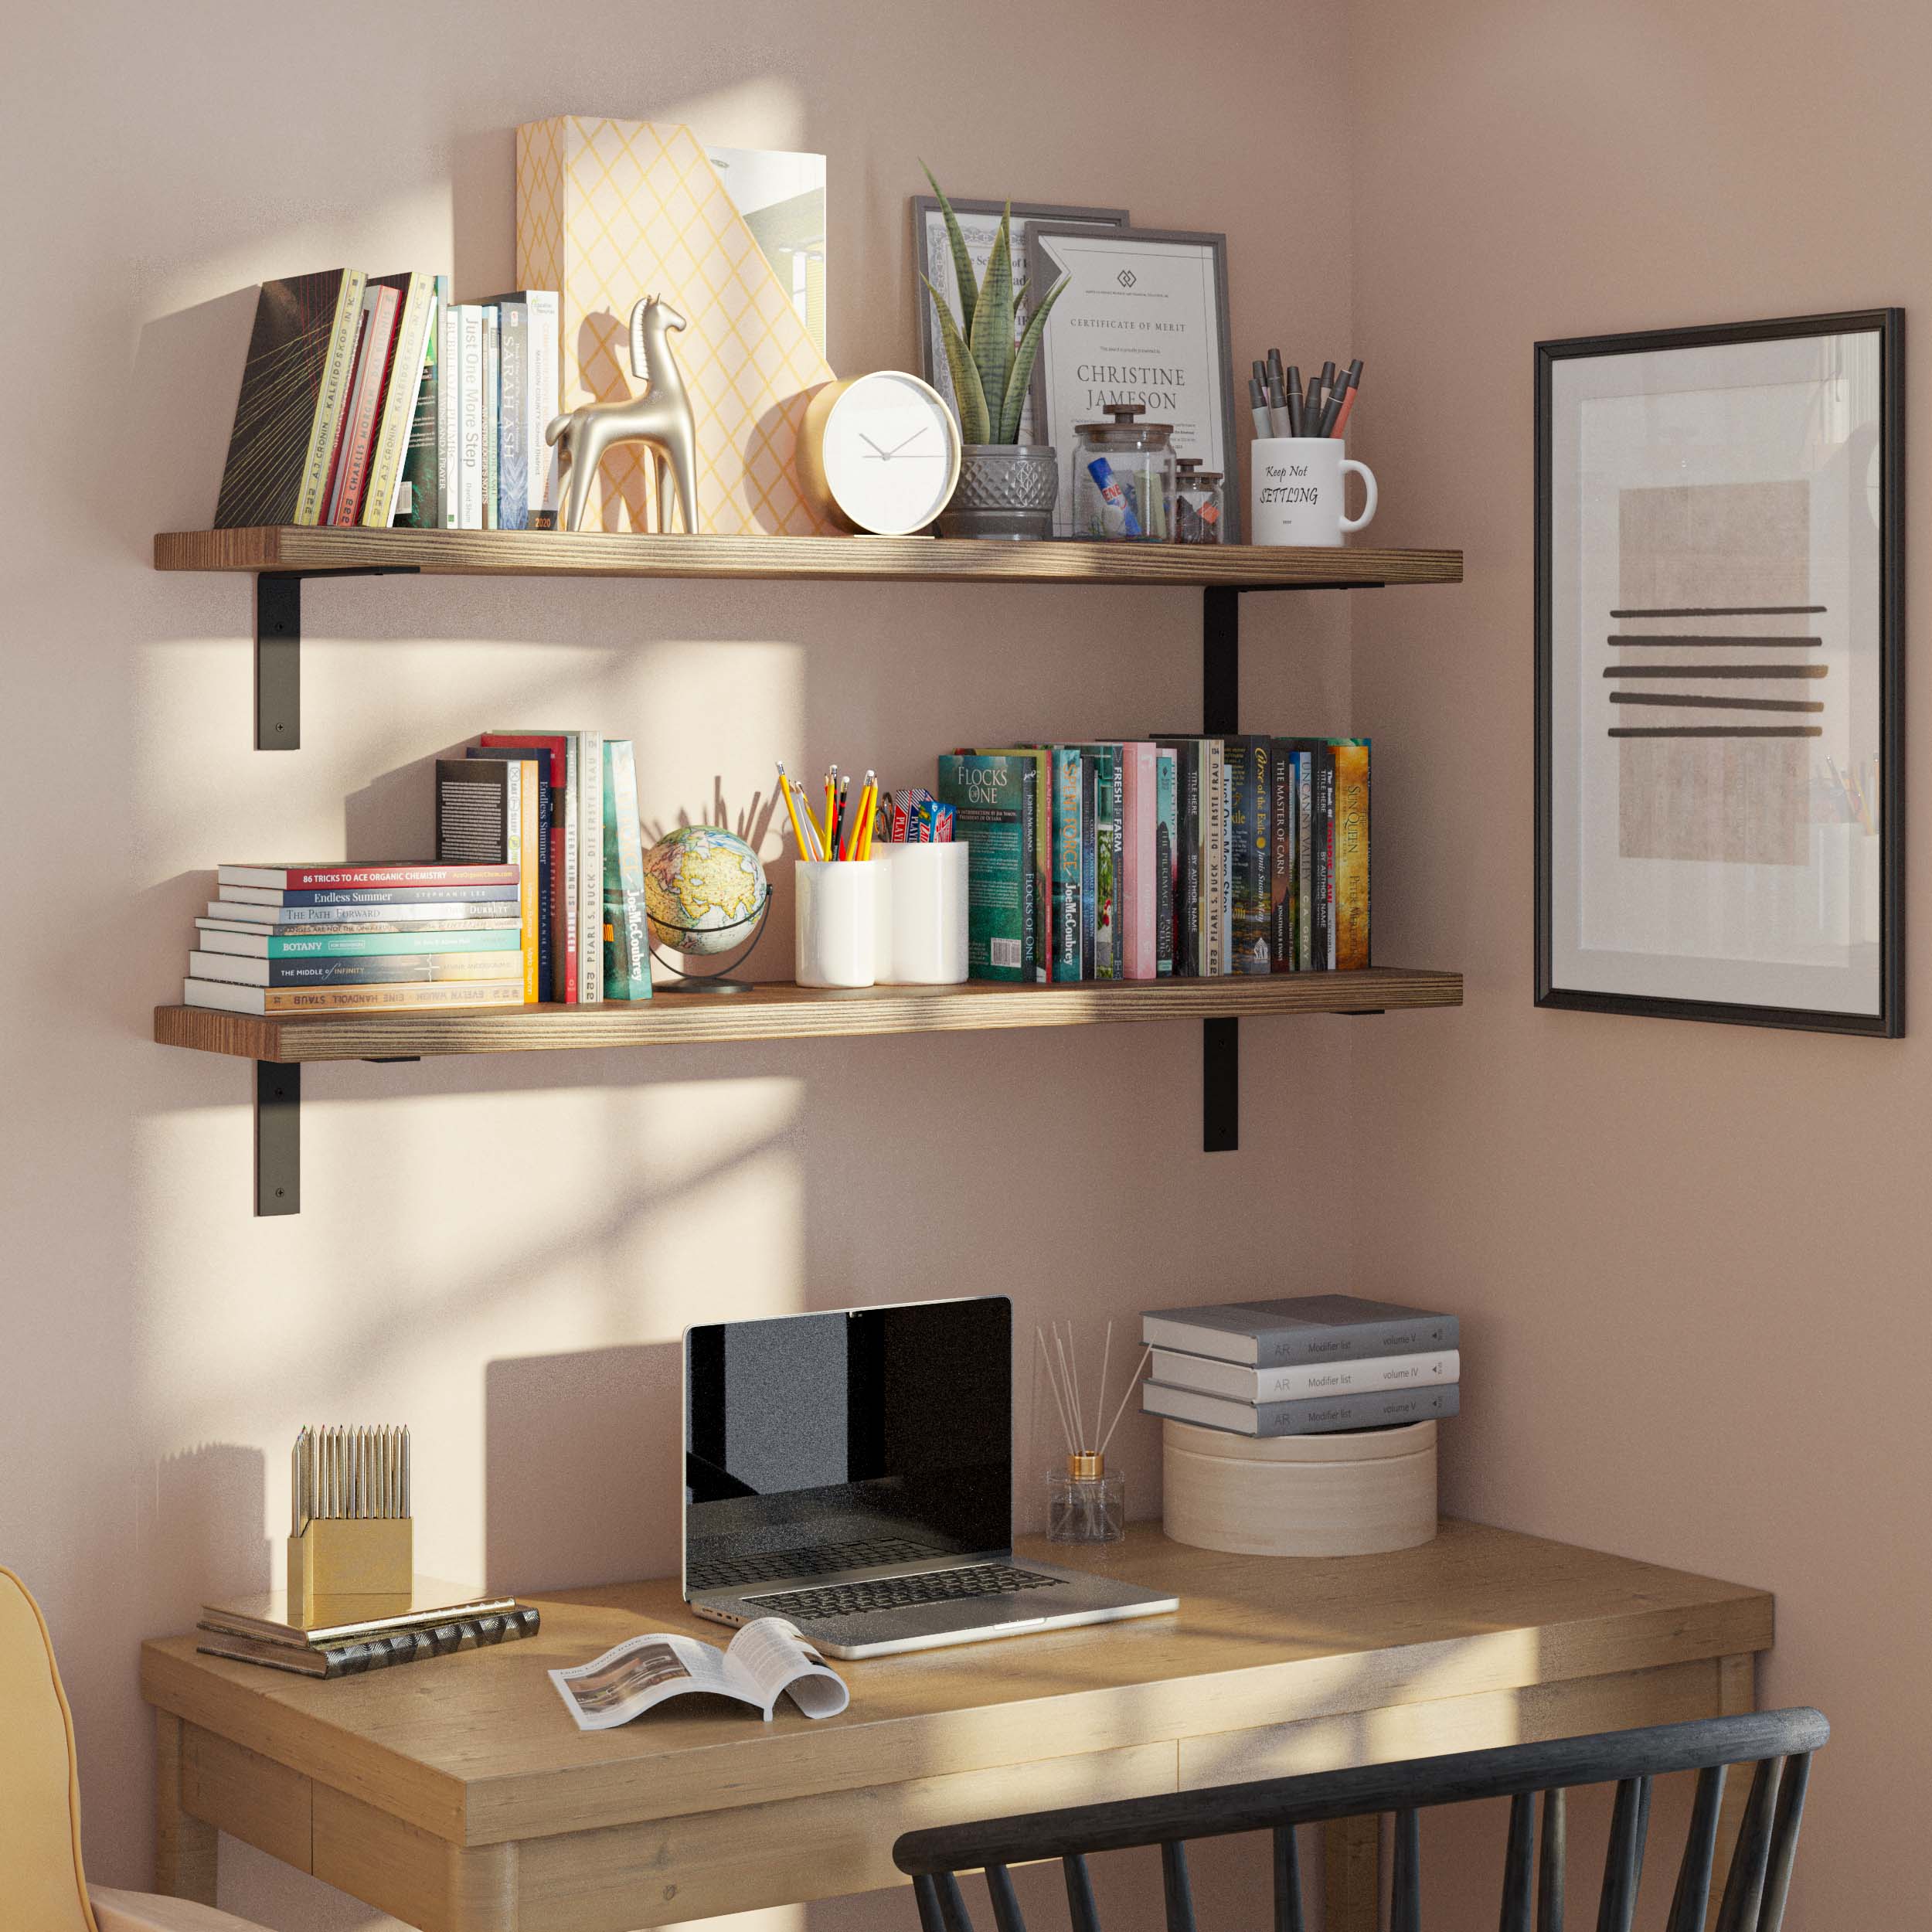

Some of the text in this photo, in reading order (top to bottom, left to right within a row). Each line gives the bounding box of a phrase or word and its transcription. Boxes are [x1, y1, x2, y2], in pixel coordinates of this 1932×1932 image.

[1070, 318, 1186, 332] CERTIFICATE OF MERIT
[1077, 364, 1186, 386] CHRISTINE
[315, 421, 329, 459] CRONIN
[325, 328, 347, 410] KALEIDOSKOP
[462, 318, 480, 468] Just One More Step
[503, 333, 516, 458] SARAH ASH
[1085, 389, 1177, 410] JAMESON
[348, 389, 378, 492] CHARLES MORGAN
[383, 423, 397, 461] CRONIN
[440, 457, 449, 490] PRAYER
[534, 448, 543, 476] District
[1266, 465, 1308, 482] Keep Not
[1260, 488, 1318, 505] SETTLING
[535, 518, 551, 529] 2020
[587, 757, 596, 789] FRAU
[958, 767, 1008, 787] FLOCKS
[1254, 747, 1268, 784] Curse
[968, 784, 998, 804] ONE
[1114, 766, 1122, 804] FRESH
[1257, 784, 1265, 795] of
[1347, 785, 1361, 810] SUN
[539, 781, 549, 865] Endless Summer
[587, 798, 596, 831] ERSTE
[1061, 763, 1078, 870] SPENT FORCE
[1277, 760, 1285, 875] THE MASTER OF CARN
[1301, 761, 1311, 882] UNCANNY VALLEY
[1114, 818, 1122, 853] FARM
[1211, 832, 1219, 849] DIE
[1344, 811, 1360, 853] QUEEN
[587, 838, 596, 858] DIE
[1191, 854, 1198, 864] BY
[1321, 851, 1327, 861] BY
[341, 874, 352, 883] TO
[369, 872, 403, 881] ORGANIC
[406, 871, 447, 880] CHEMISTRY
[1211, 864, 1219, 893] BUCK
[1255, 850, 1266, 923] Janis Susan May
[1349, 875, 1361, 903] PETER
[314, 893, 393, 903] Endless Summer
[569, 896, 576, 906] IS
[587, 911, 596, 920] S.
[1025, 873, 1035, 961] FLOCKS OF ONE
[1063, 882, 1080, 967] JoeMcCoubrey
[627, 887, 645, 981] JoeMcCoubrey
[283, 942, 322, 952] BOTANY
[334, 967, 366, 975] INFINITY
[294, 990, 485, 1005] EVELYN WAUGH EINE HANDVOLL STAUB
[1274, 1333, 1417, 1355] AR Modifier list volume V
[1274, 1368, 1419, 1392] AR Modifier list volume IV
[1274, 1402, 1417, 1426] AR Modifier list volume V
